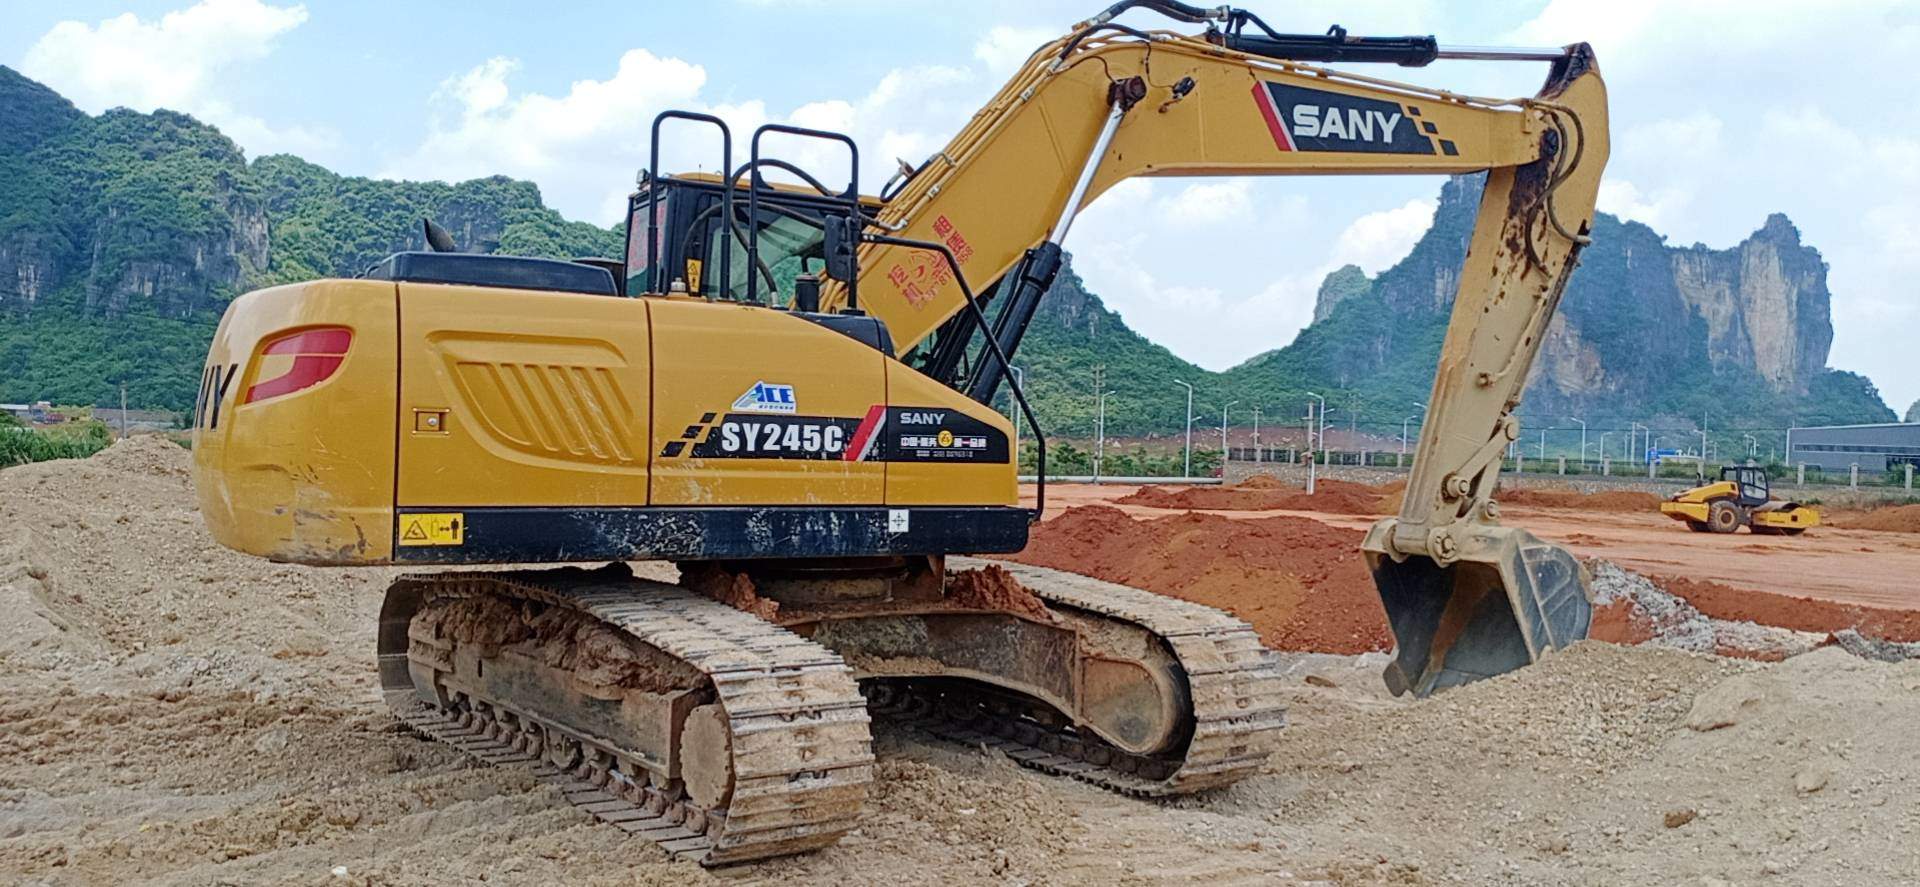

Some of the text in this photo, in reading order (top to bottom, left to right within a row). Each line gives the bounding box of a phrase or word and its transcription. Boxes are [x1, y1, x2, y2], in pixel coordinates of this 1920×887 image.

[1293, 104, 1401, 144] SANY
[900, 412, 945, 425] SANY
[721, 422, 843, 452] SY245C
